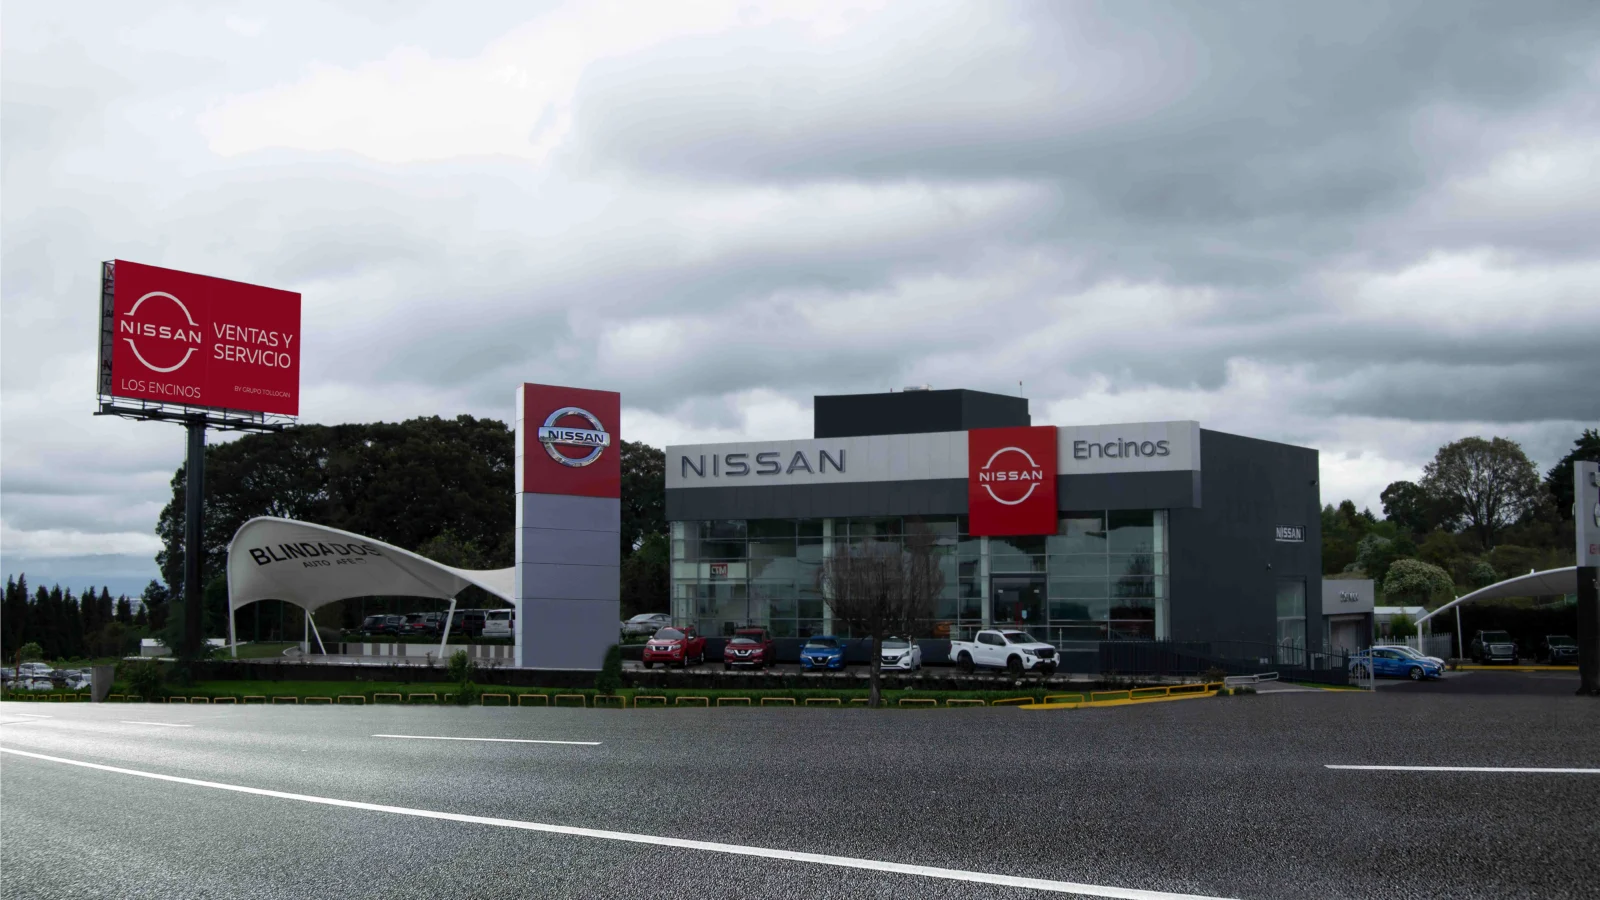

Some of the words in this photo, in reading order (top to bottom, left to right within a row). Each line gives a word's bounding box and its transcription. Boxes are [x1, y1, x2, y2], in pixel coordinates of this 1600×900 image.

[120, 319, 202, 344] NISSAN
[213, 321, 279, 347] VENTAS
[282, 333, 293, 349] Y
[213, 343, 291, 369] SERVICIO
[121, 378, 146, 392] LOS
[149, 381, 201, 399] ENCINOS
[242, 386, 262, 395] GRUPO
[548, 430, 604, 443] NISSAN
[1073, 437, 1170, 460] Encinos
[681, 449, 847, 478] NISSAN
[979, 470, 1043, 482] NISSAN
[1276, 527, 1302, 539] NISSAN
[249, 542, 383, 566] BLINDADOS
[303, 559, 331, 568] AUTO
